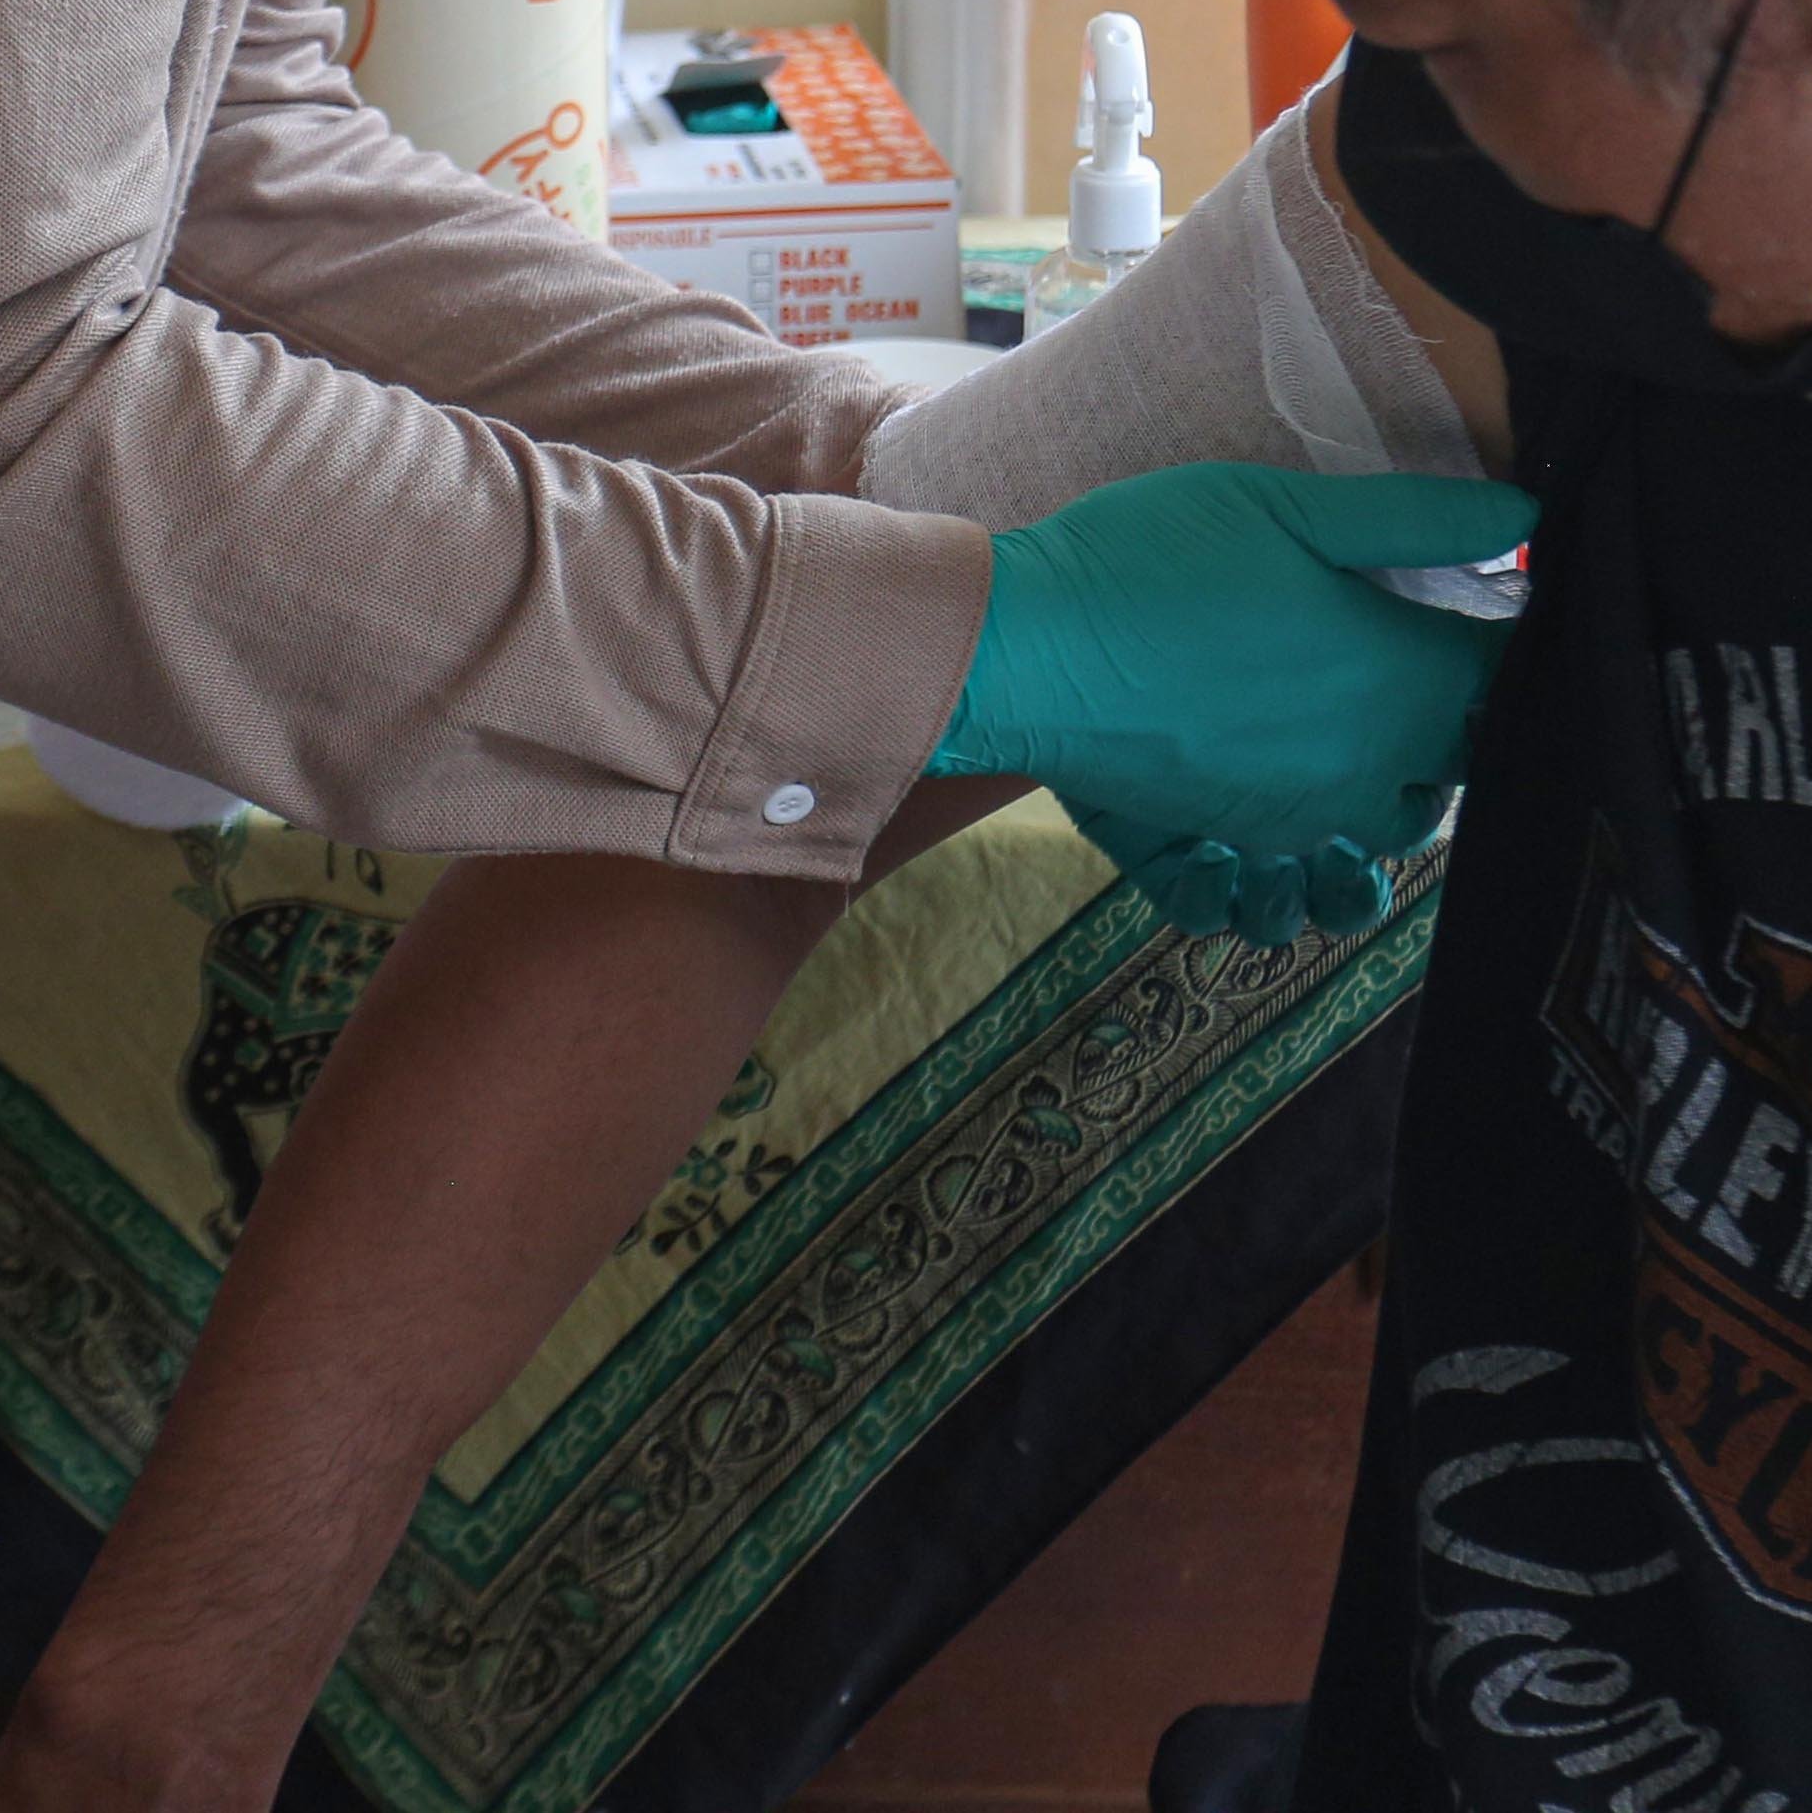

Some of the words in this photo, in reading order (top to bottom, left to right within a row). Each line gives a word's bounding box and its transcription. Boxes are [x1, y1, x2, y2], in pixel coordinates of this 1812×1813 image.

[780, 247, 850, 270] BLACK
[780, 272, 864, 297] PURPLE
[780, 302, 833, 326] BLUE
[845, 299, 922, 323] OCEAN
